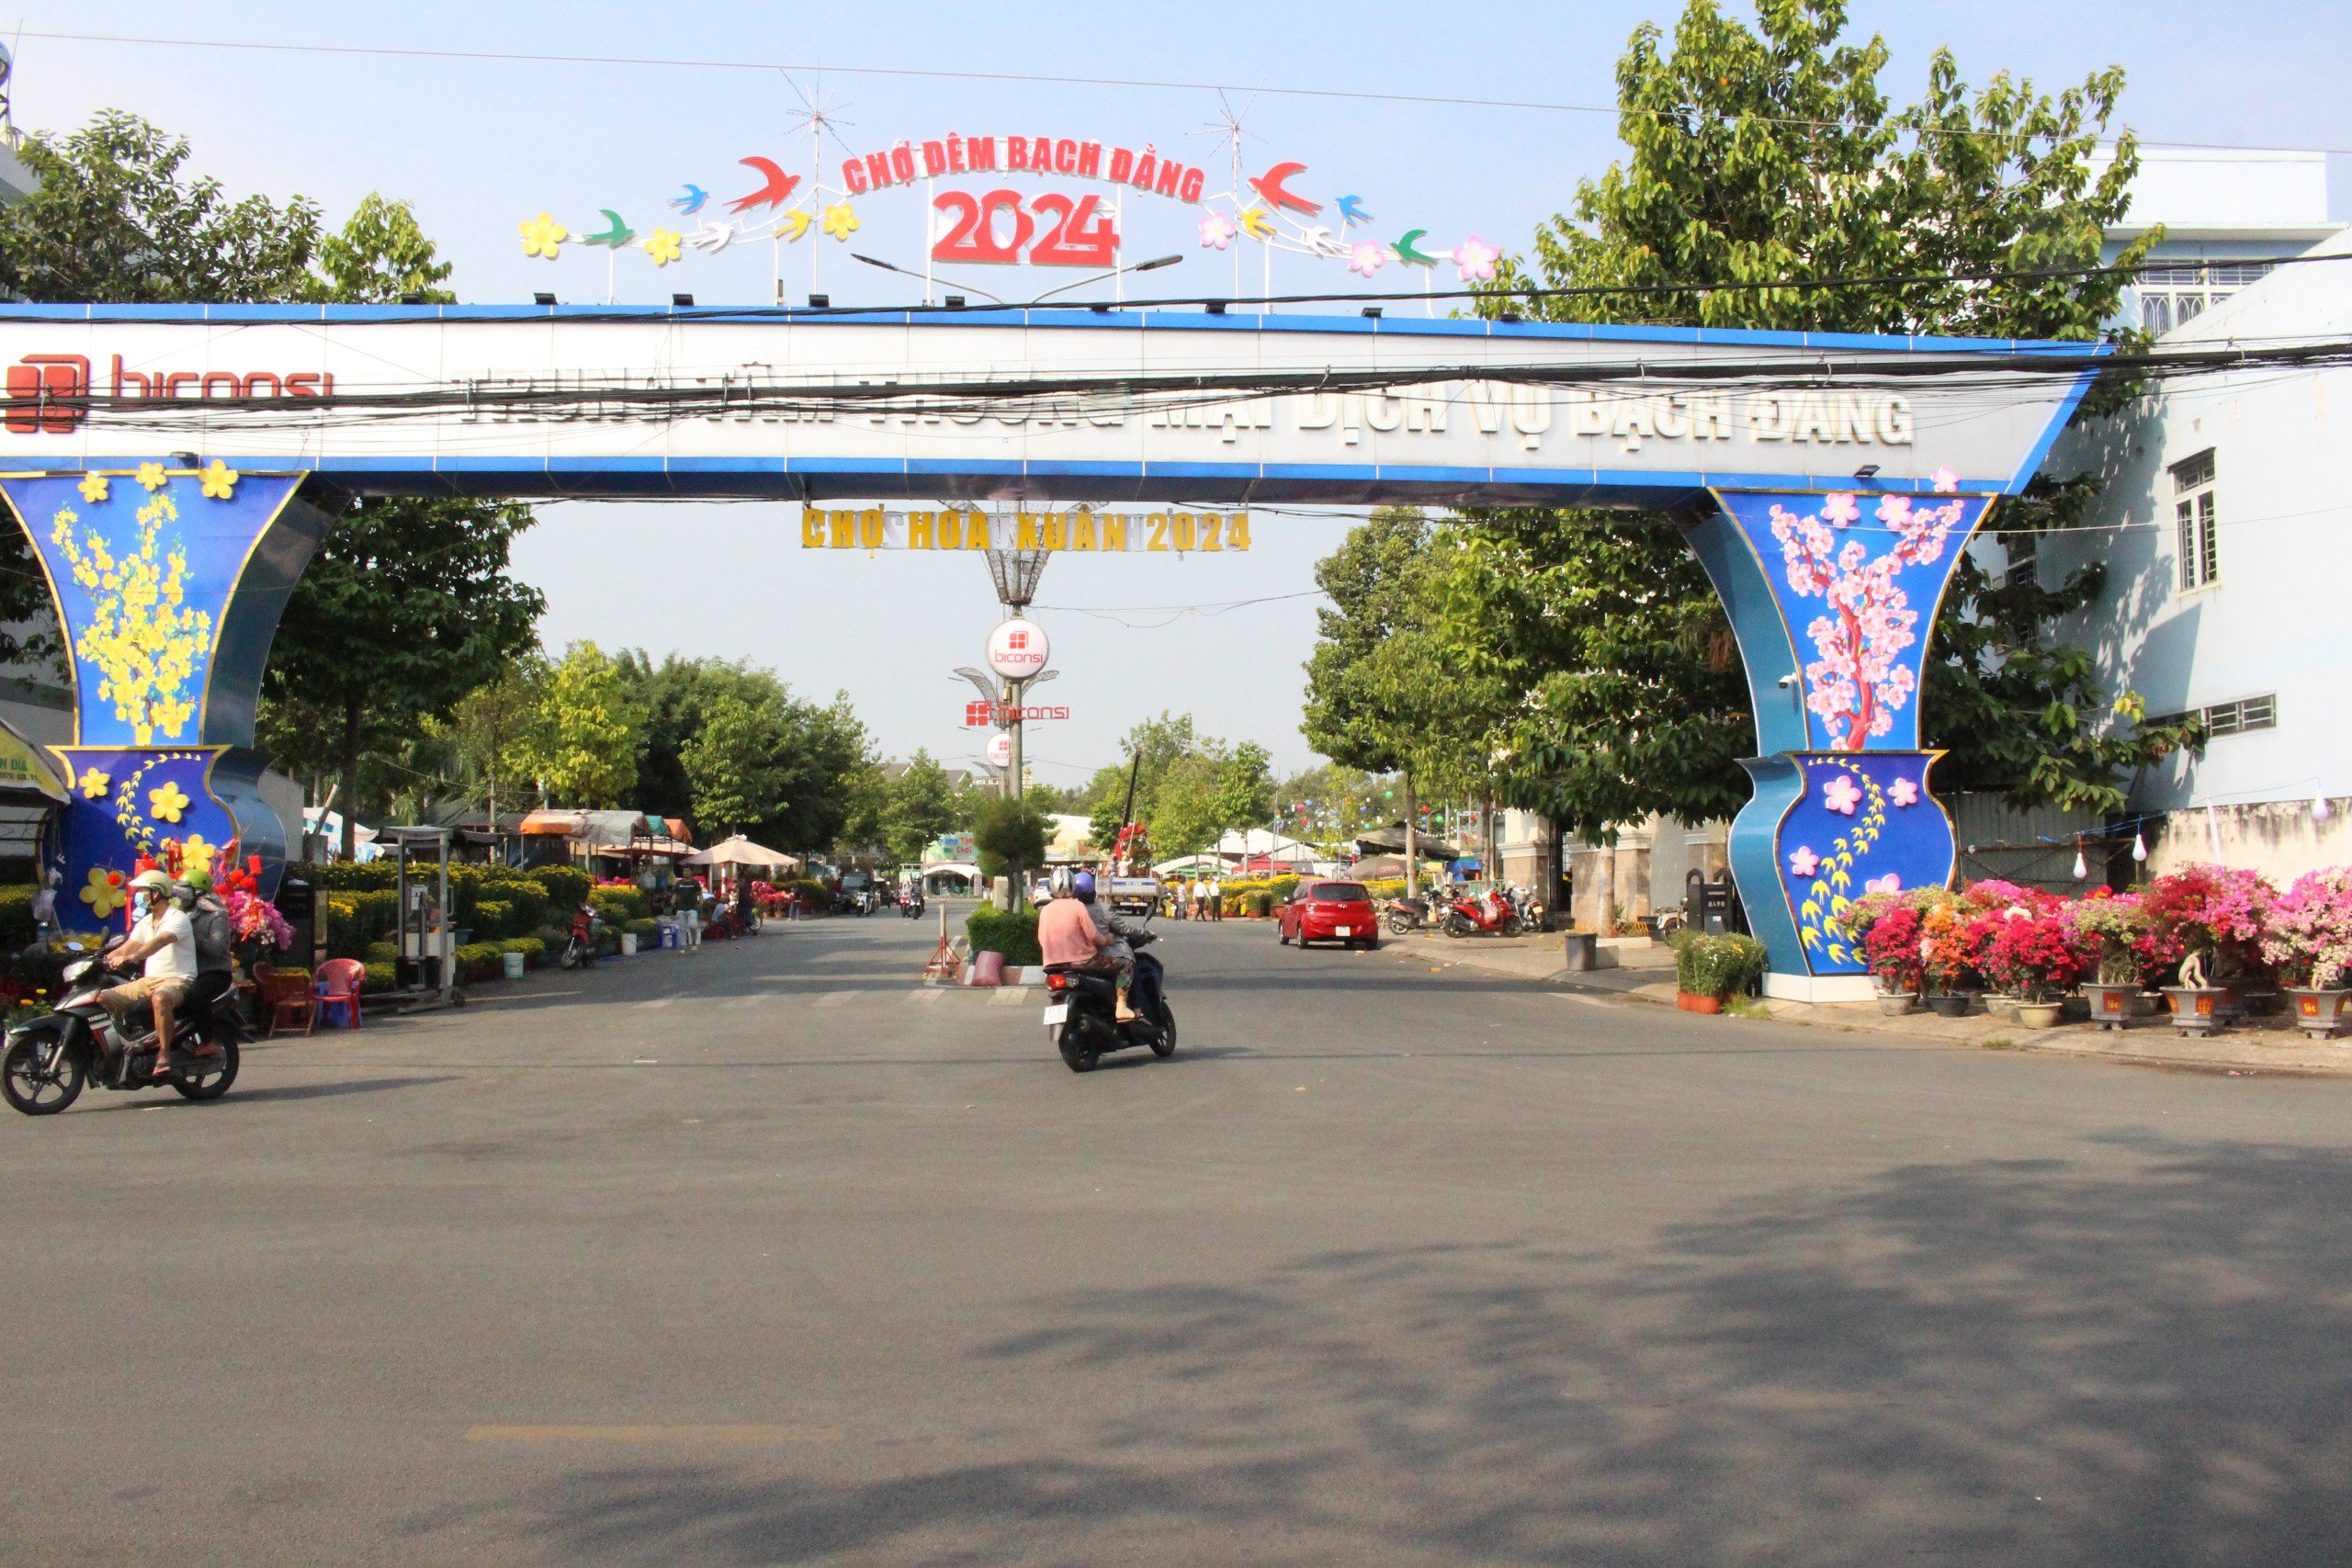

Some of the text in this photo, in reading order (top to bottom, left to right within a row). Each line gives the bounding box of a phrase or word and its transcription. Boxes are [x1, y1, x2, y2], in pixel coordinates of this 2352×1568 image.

[842, 140, 916, 193] CHỢ
[922, 131, 996, 175] ĐÊM
[1007, 136, 1102, 176] BẠCH
[931, 189, 1120, 265] 2024
[1297, 378, 1447, 445] DỊCH
[1468, 378, 1552, 449] VỤ
[1574, 386, 1732, 451] BẠCH
[802, 503, 1251, 558] CHỢ HOA XUÂN 2024
[995, 649, 1043, 663] biconsi
